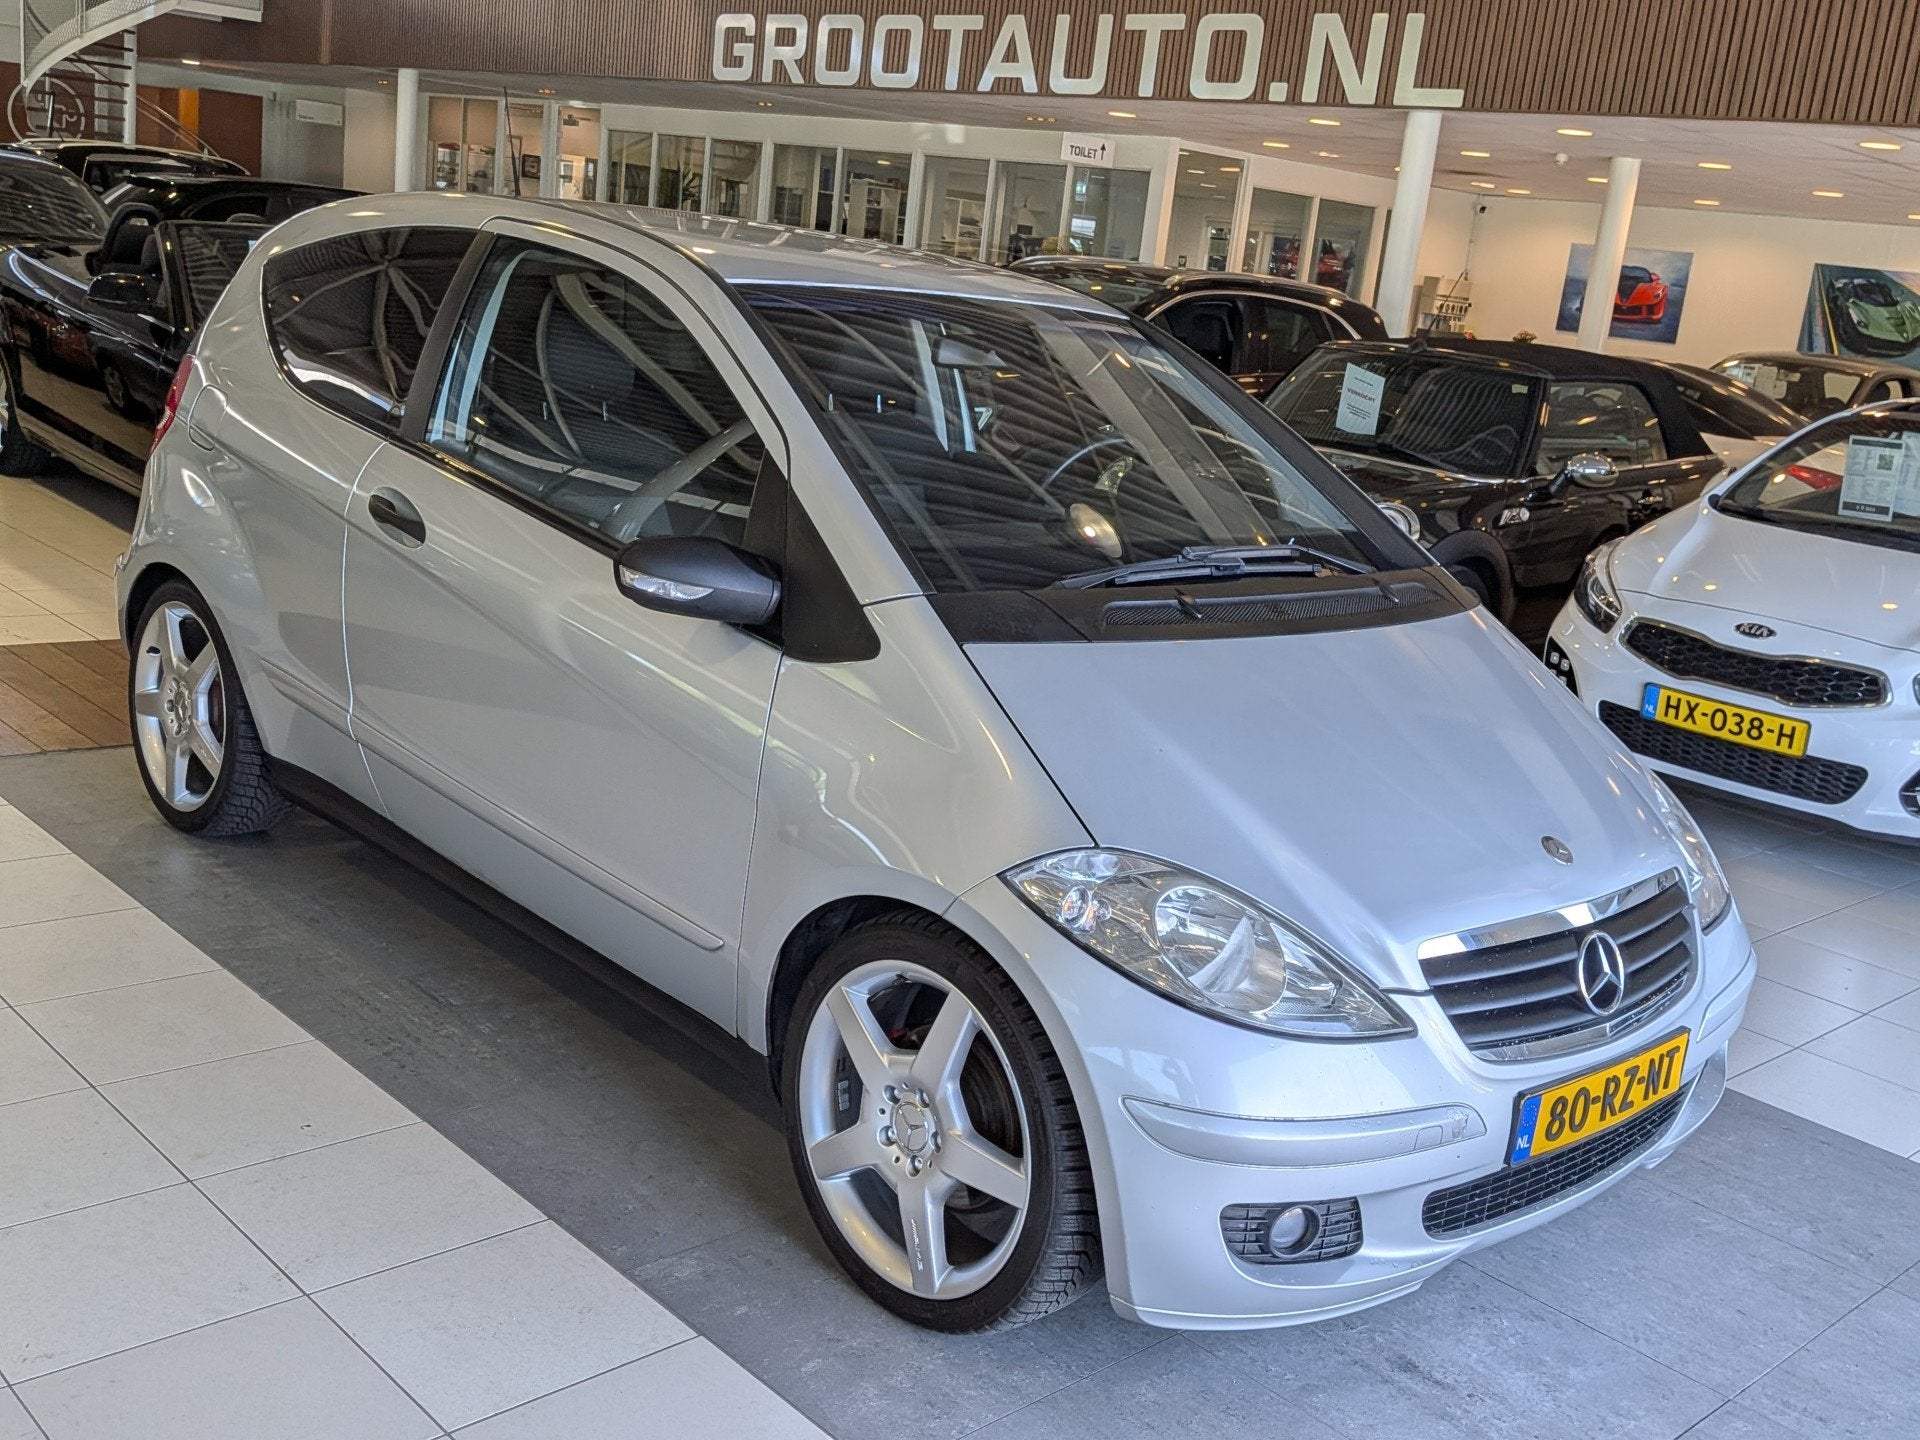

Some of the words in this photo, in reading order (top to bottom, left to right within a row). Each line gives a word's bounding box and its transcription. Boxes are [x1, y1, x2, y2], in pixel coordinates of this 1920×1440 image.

[712, 13, 1465, 108] GROOTAUTO.NL
[1069, 144, 1098, 159] TOILET
[1739, 622, 1770, 637] KIA
[1644, 703, 1656, 714] NL
[1664, 694, 1797, 750] HX-038-H
[1544, 1045, 1681, 1142] 80-RZ-NT
[1516, 1134, 1530, 1150] NL
